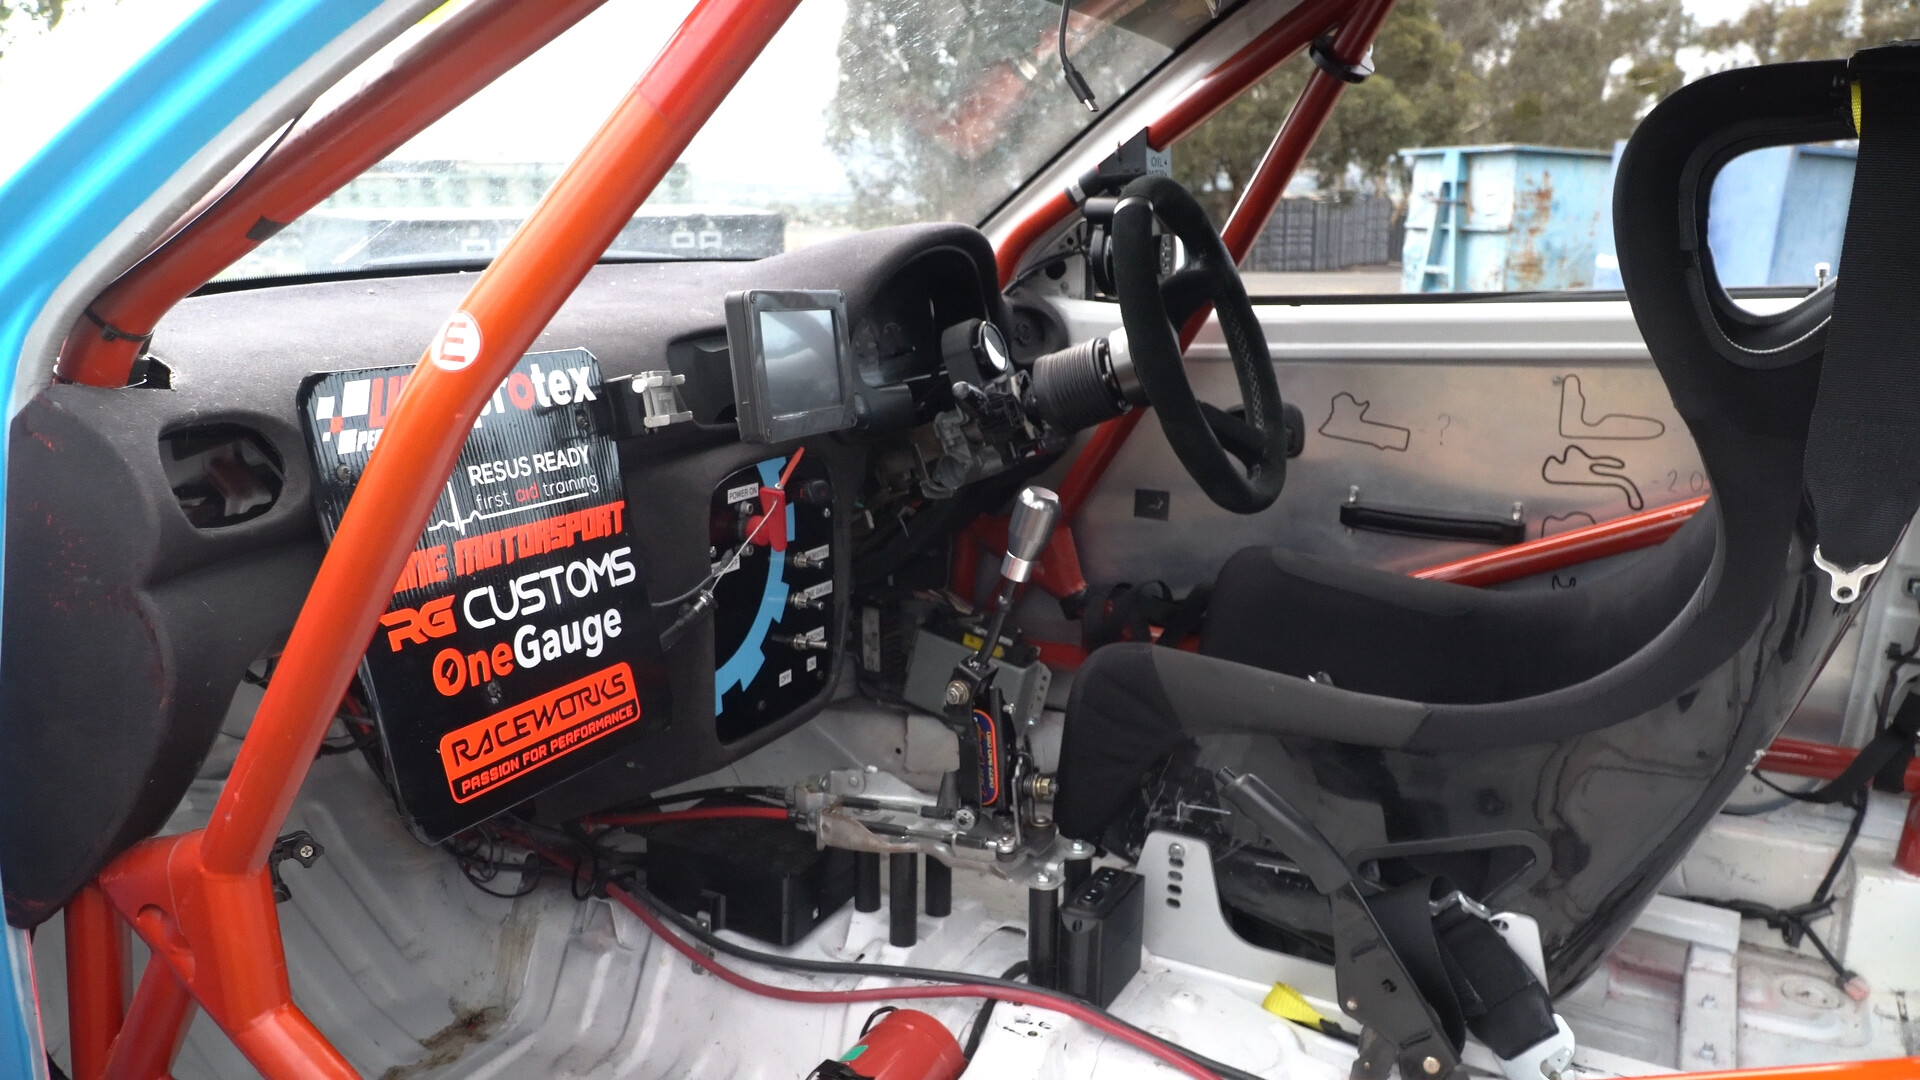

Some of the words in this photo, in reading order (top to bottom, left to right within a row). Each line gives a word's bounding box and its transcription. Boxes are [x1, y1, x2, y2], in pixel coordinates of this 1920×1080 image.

[474, 363, 597, 428] rotex
[467, 456, 532, 487] RESUS
[532, 445, 589, 474] READY
[476, 491, 509, 511] first
[515, 482, 540, 503] aid
[543, 474, 599, 497] training
[729, 488, 749, 500] POWER
[749, 485, 758, 495] ON
[454, 500, 627, 578] MOTORSPORT
[380, 595, 458, 653] RG
[463, 546, 636, 629] CUSTOMS
[432, 608, 622, 697] OneGauge
[452, 672, 627, 768] RACEWORKS
[461, 757, 520, 795] PASSION
[522, 743, 548, 766] FOR
[550, 704, 634, 753] PERFORMANCE
